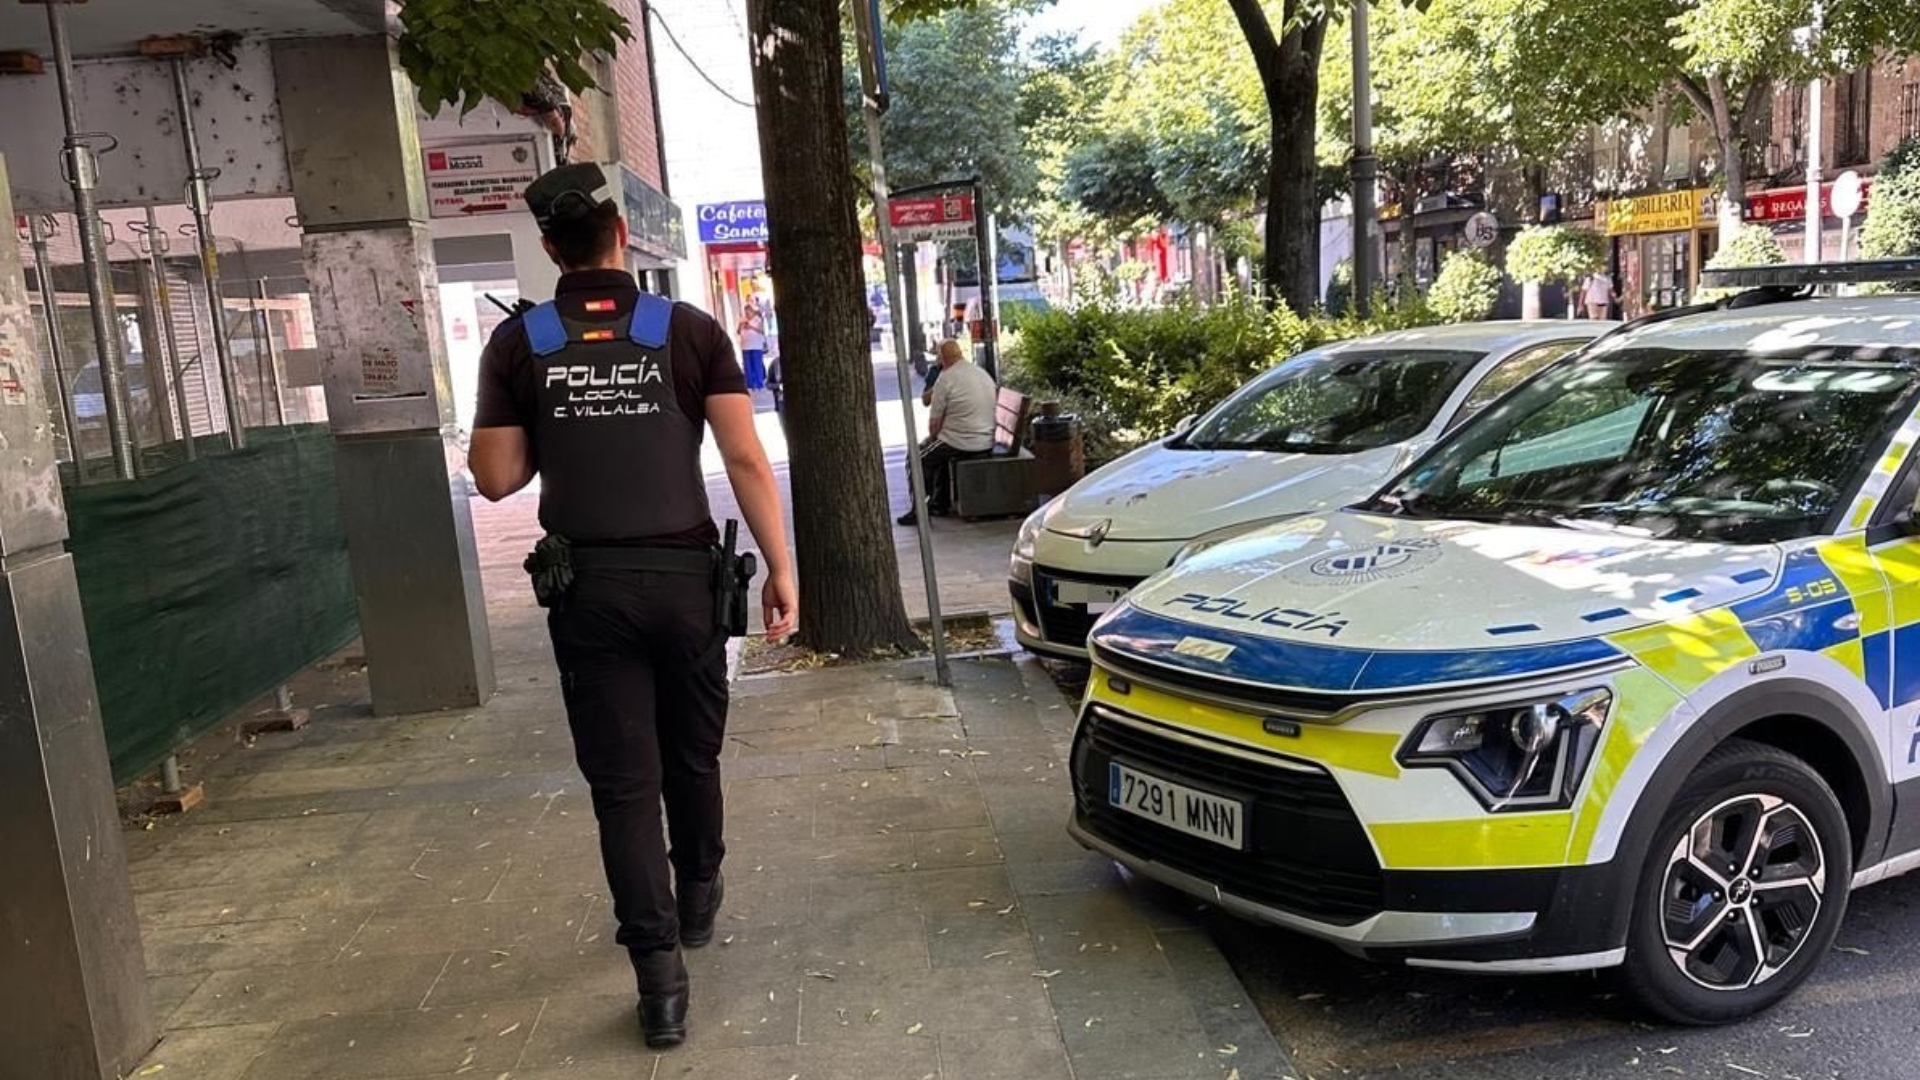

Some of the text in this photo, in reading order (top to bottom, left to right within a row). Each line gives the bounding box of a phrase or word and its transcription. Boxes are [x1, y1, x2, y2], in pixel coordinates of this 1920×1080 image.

[1771, 198, 1827, 213] REGAS
[546, 355, 662, 389] POLICÍA
[568, 390, 642, 401] LOCAL
[574, 402, 660, 417] VILLALBA
[1163, 593, 1349, 638] POLICÍA
[1124, 773, 1235, 841] 7291 MNN
